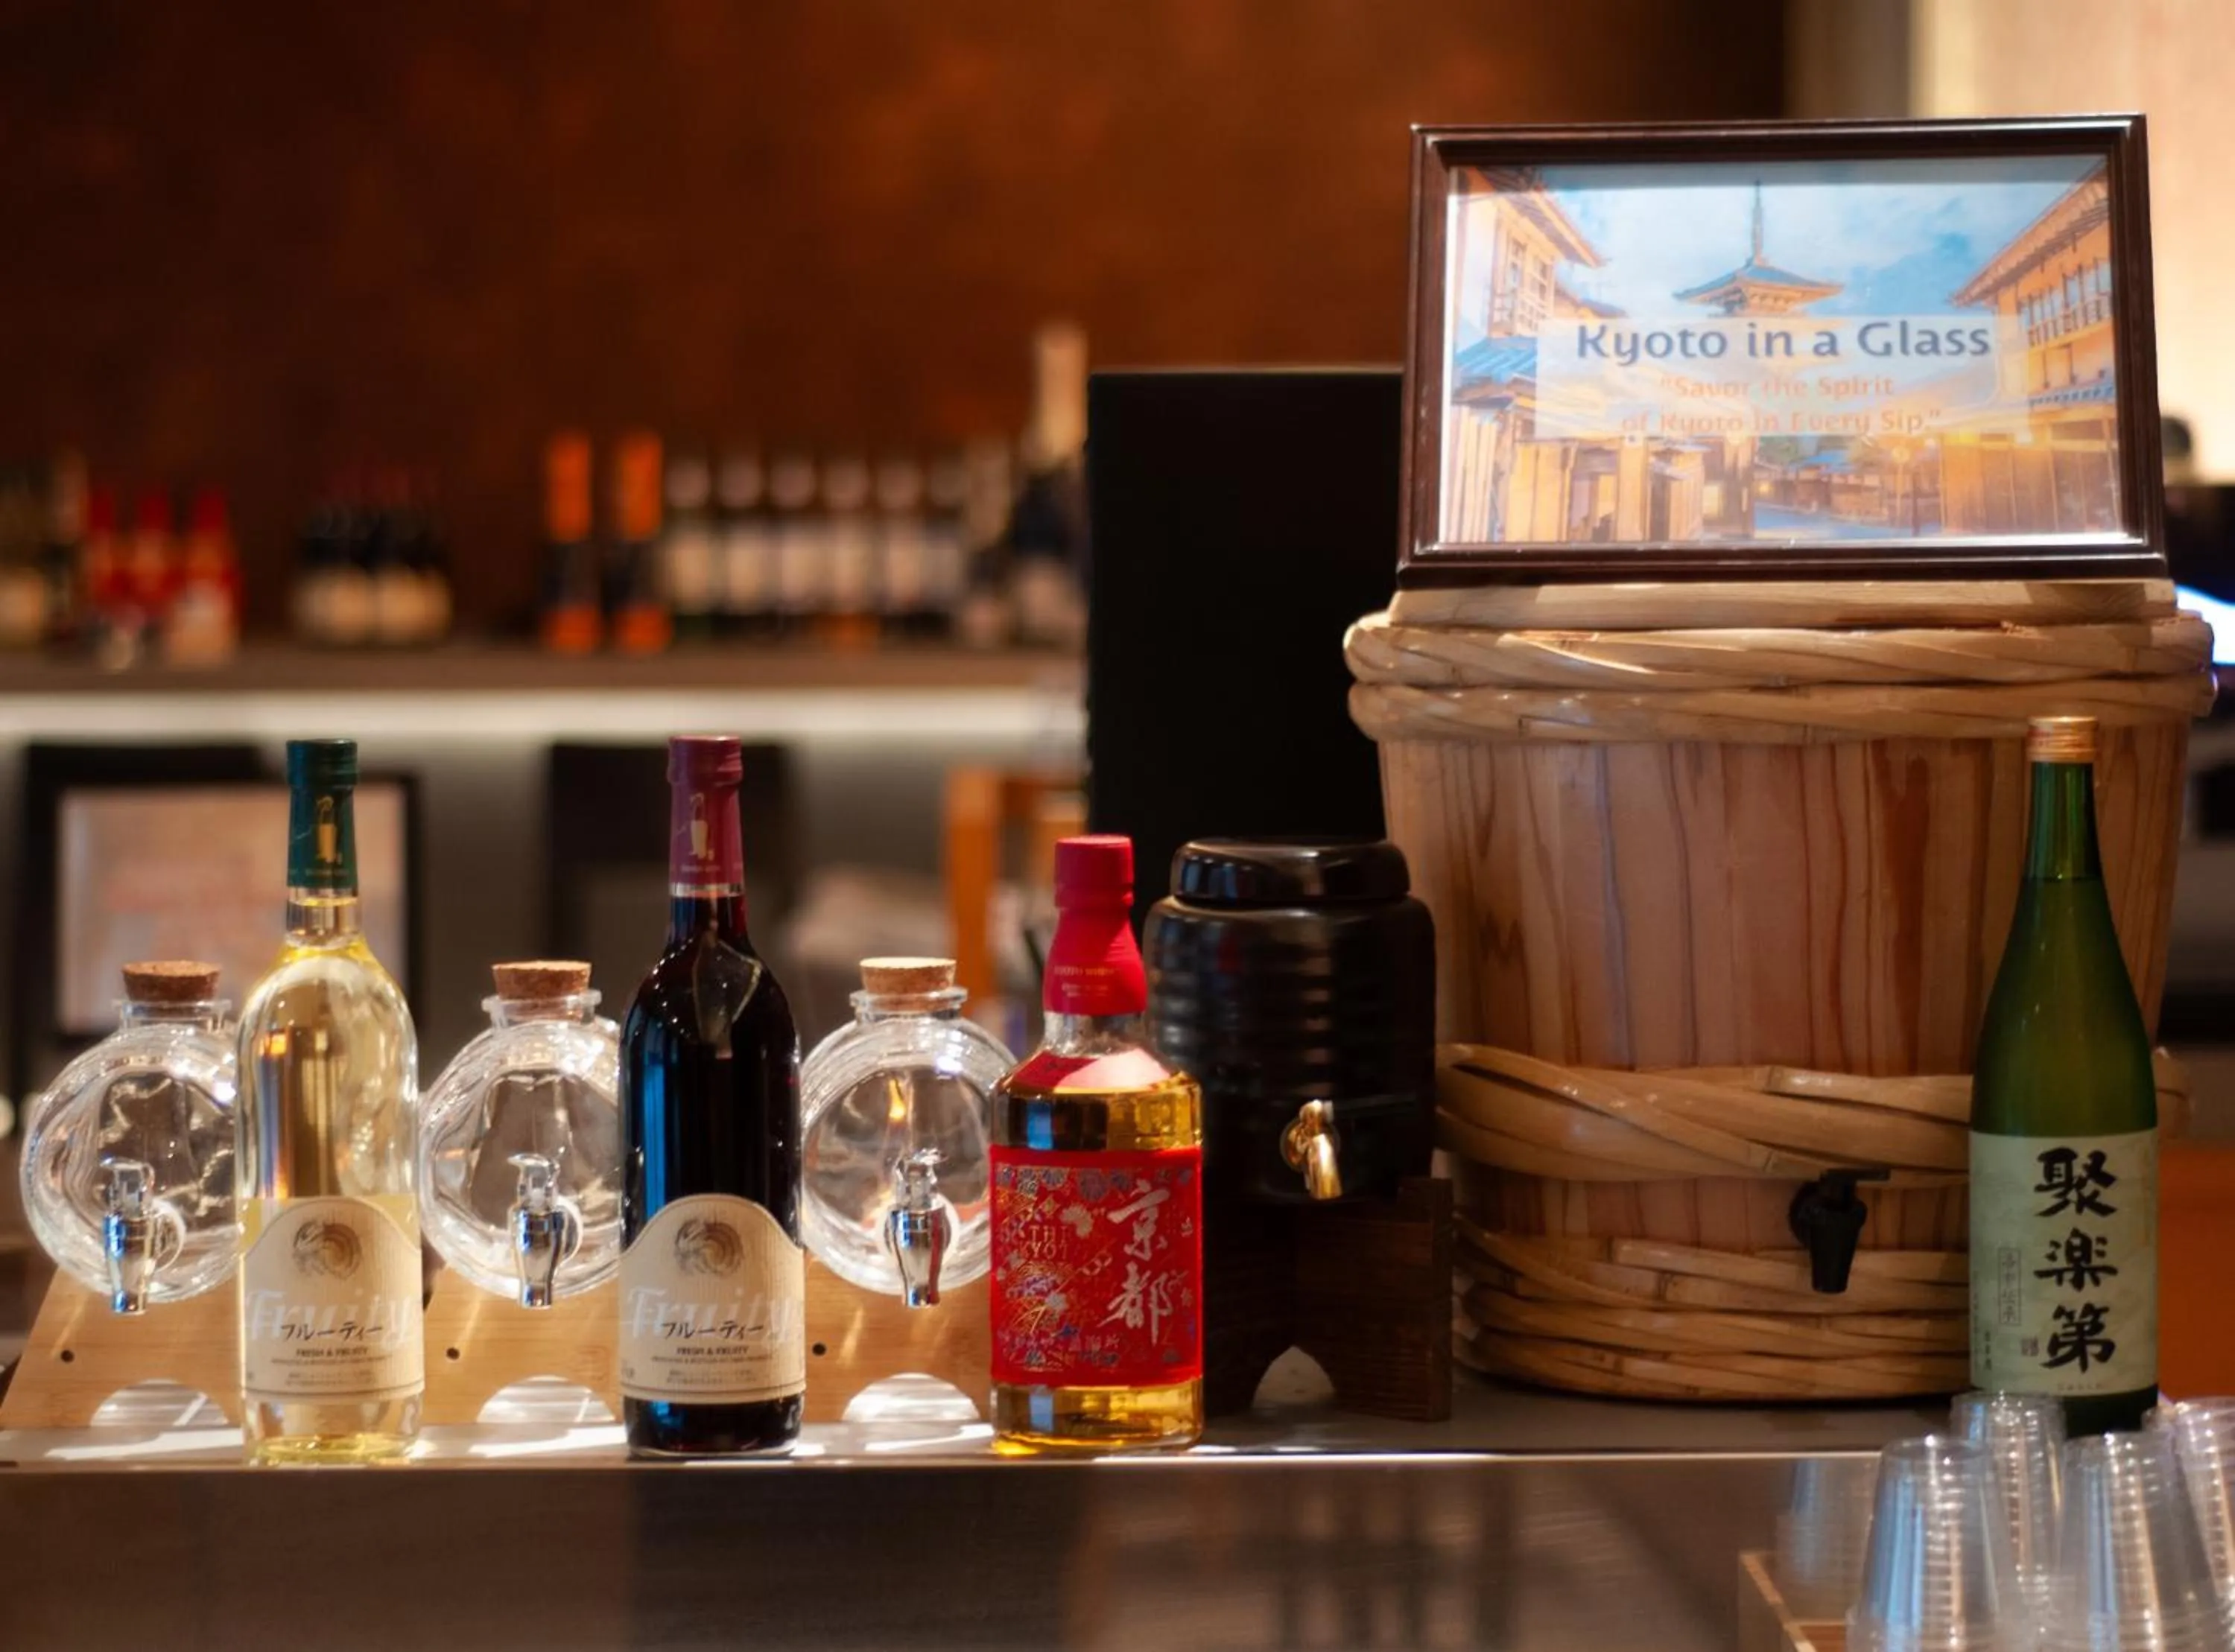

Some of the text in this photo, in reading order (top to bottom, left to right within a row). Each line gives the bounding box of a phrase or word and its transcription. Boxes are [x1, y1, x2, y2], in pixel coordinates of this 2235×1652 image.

[1578, 320, 1991, 367] Kyoto in a Glass
[1763, 375, 1809, 397] the
[1818, 374, 1895, 400] Spirit
[1620, 410, 1648, 433] of
[1660, 413, 1743, 436] Kyoto
[1754, 412, 1781, 431] in
[1792, 411, 1870, 436] Every
[1097, 1178, 1174, 1347] 京都
[2034, 1146, 2118, 1373] 聚楽第
[280, 1321, 383, 1341] フルーティー
[661, 1320, 764, 1340] フルーティー
